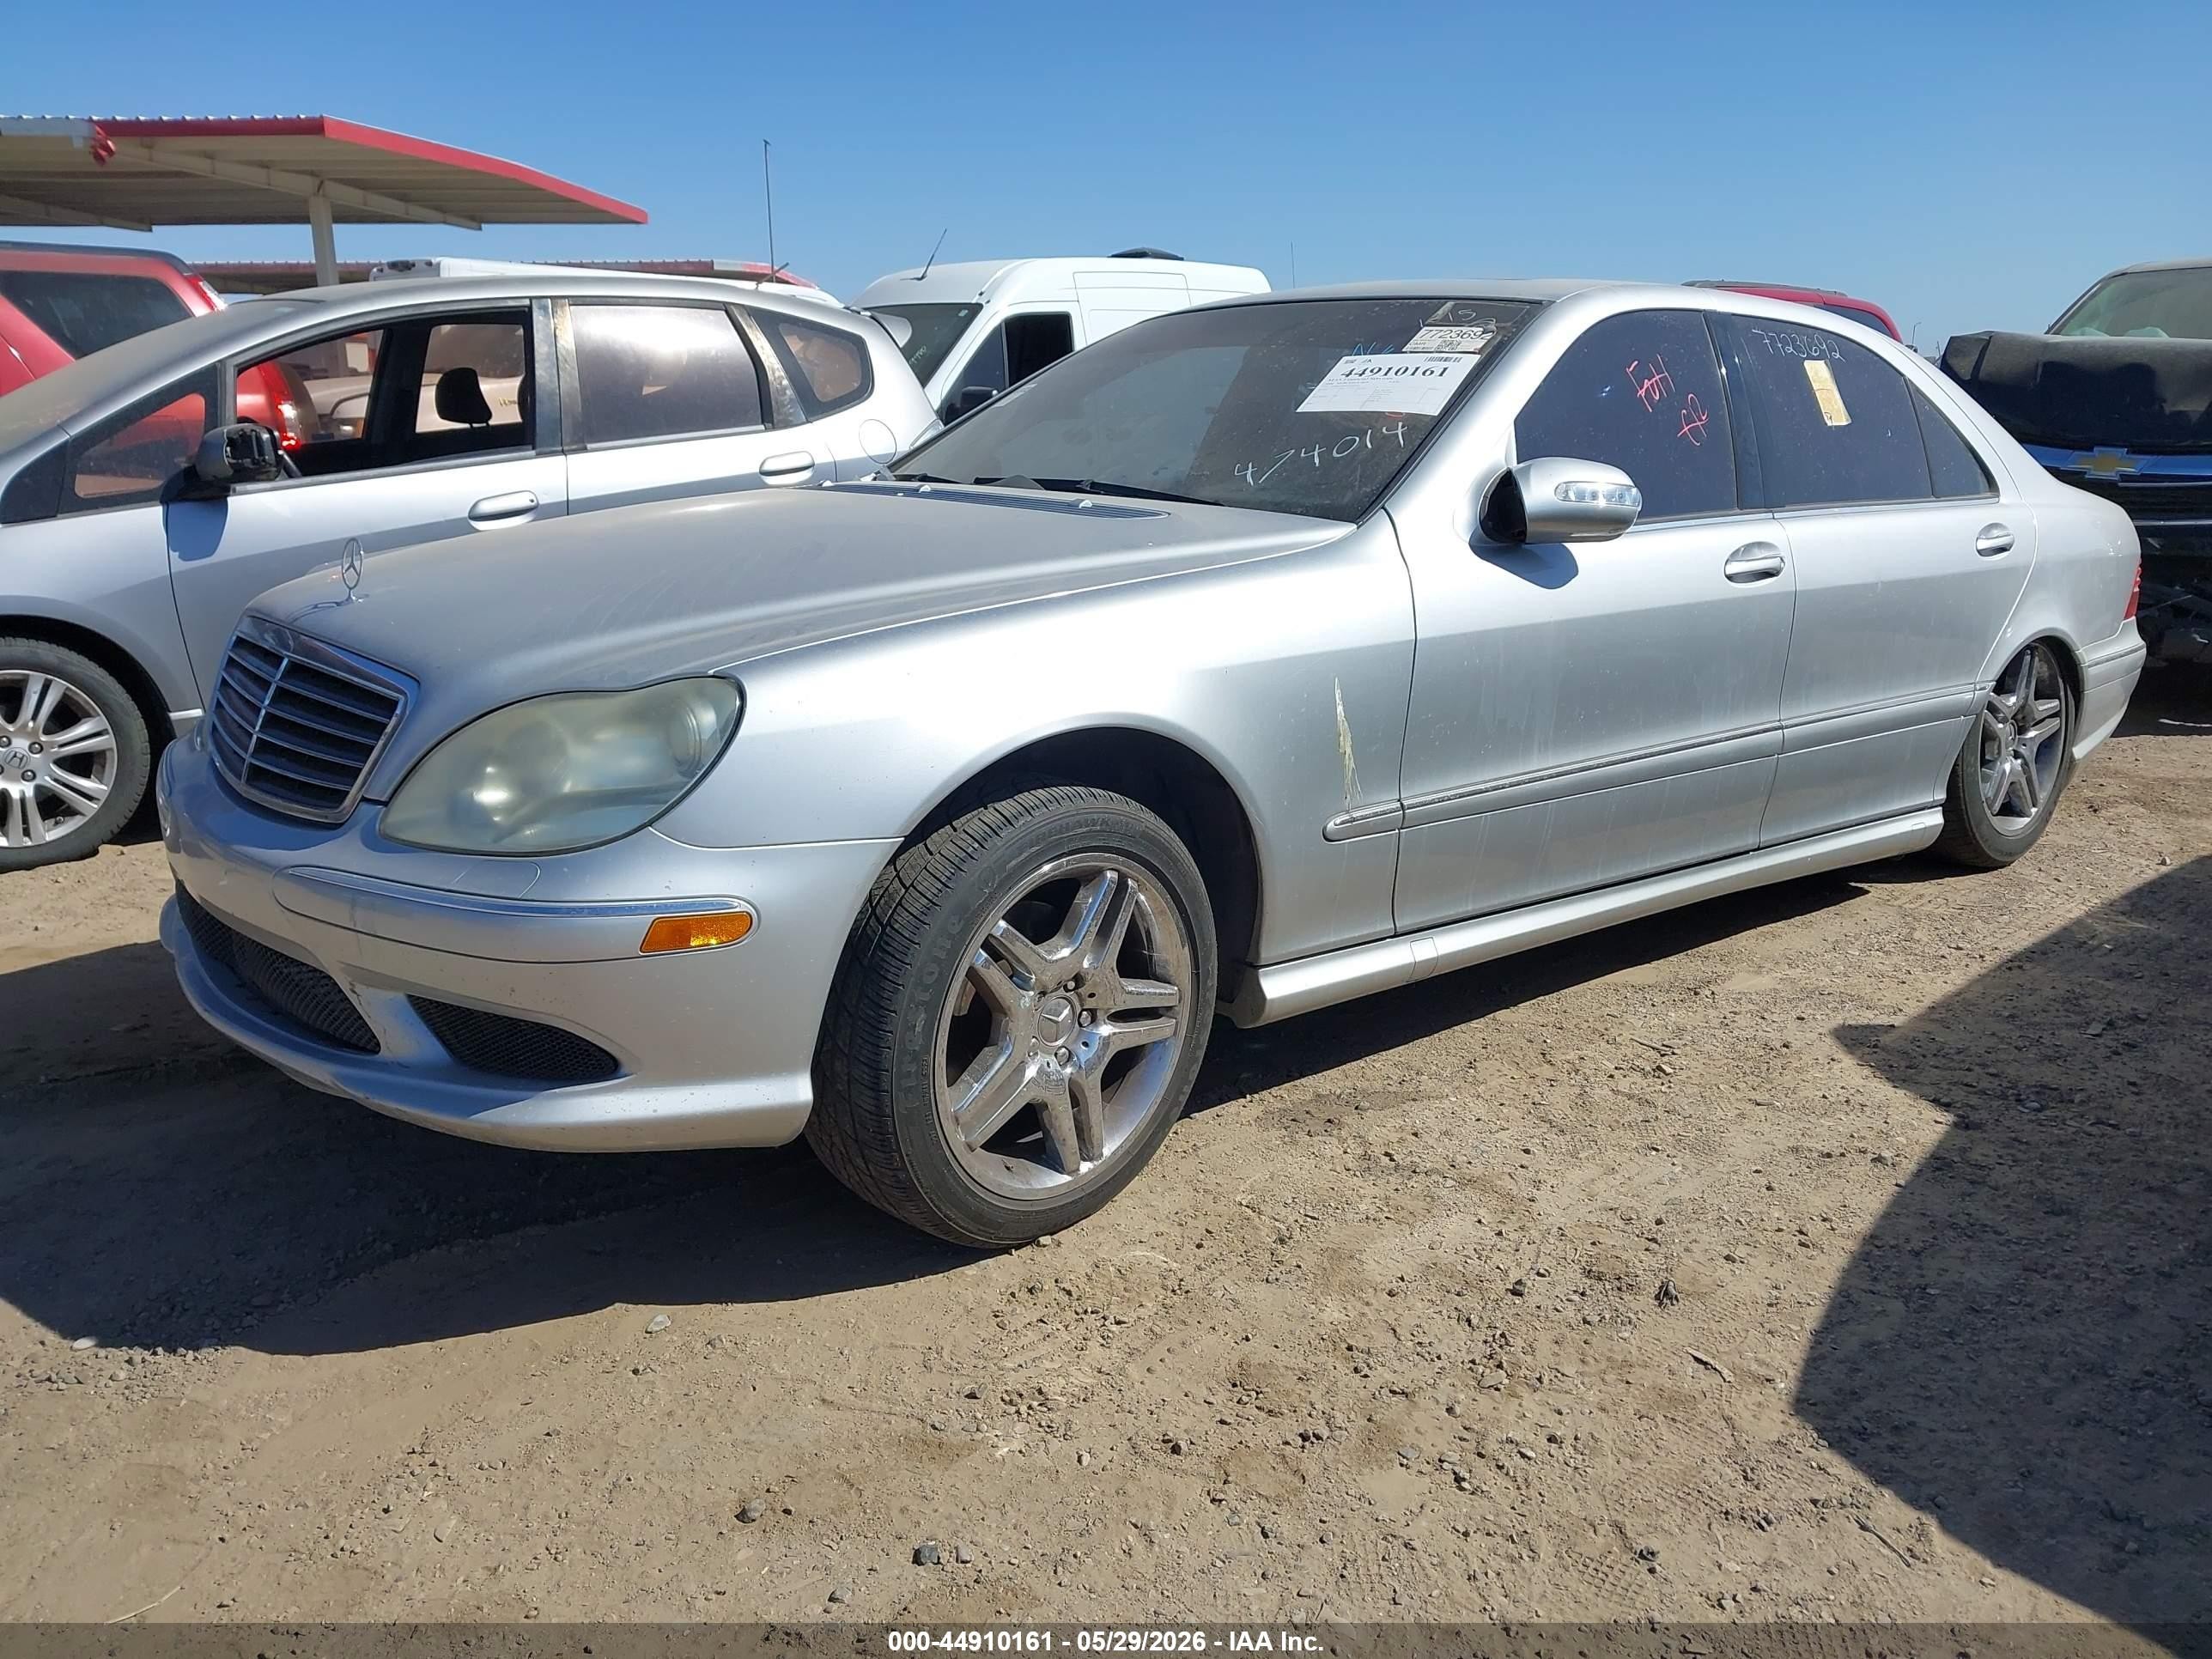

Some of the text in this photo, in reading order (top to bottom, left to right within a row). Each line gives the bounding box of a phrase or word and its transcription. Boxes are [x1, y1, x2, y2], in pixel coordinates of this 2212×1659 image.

[1419, 329, 1496, 340] 7723692
[1752, 329, 1845, 362] 7723692
[1340, 365, 1450, 378] 44910161
